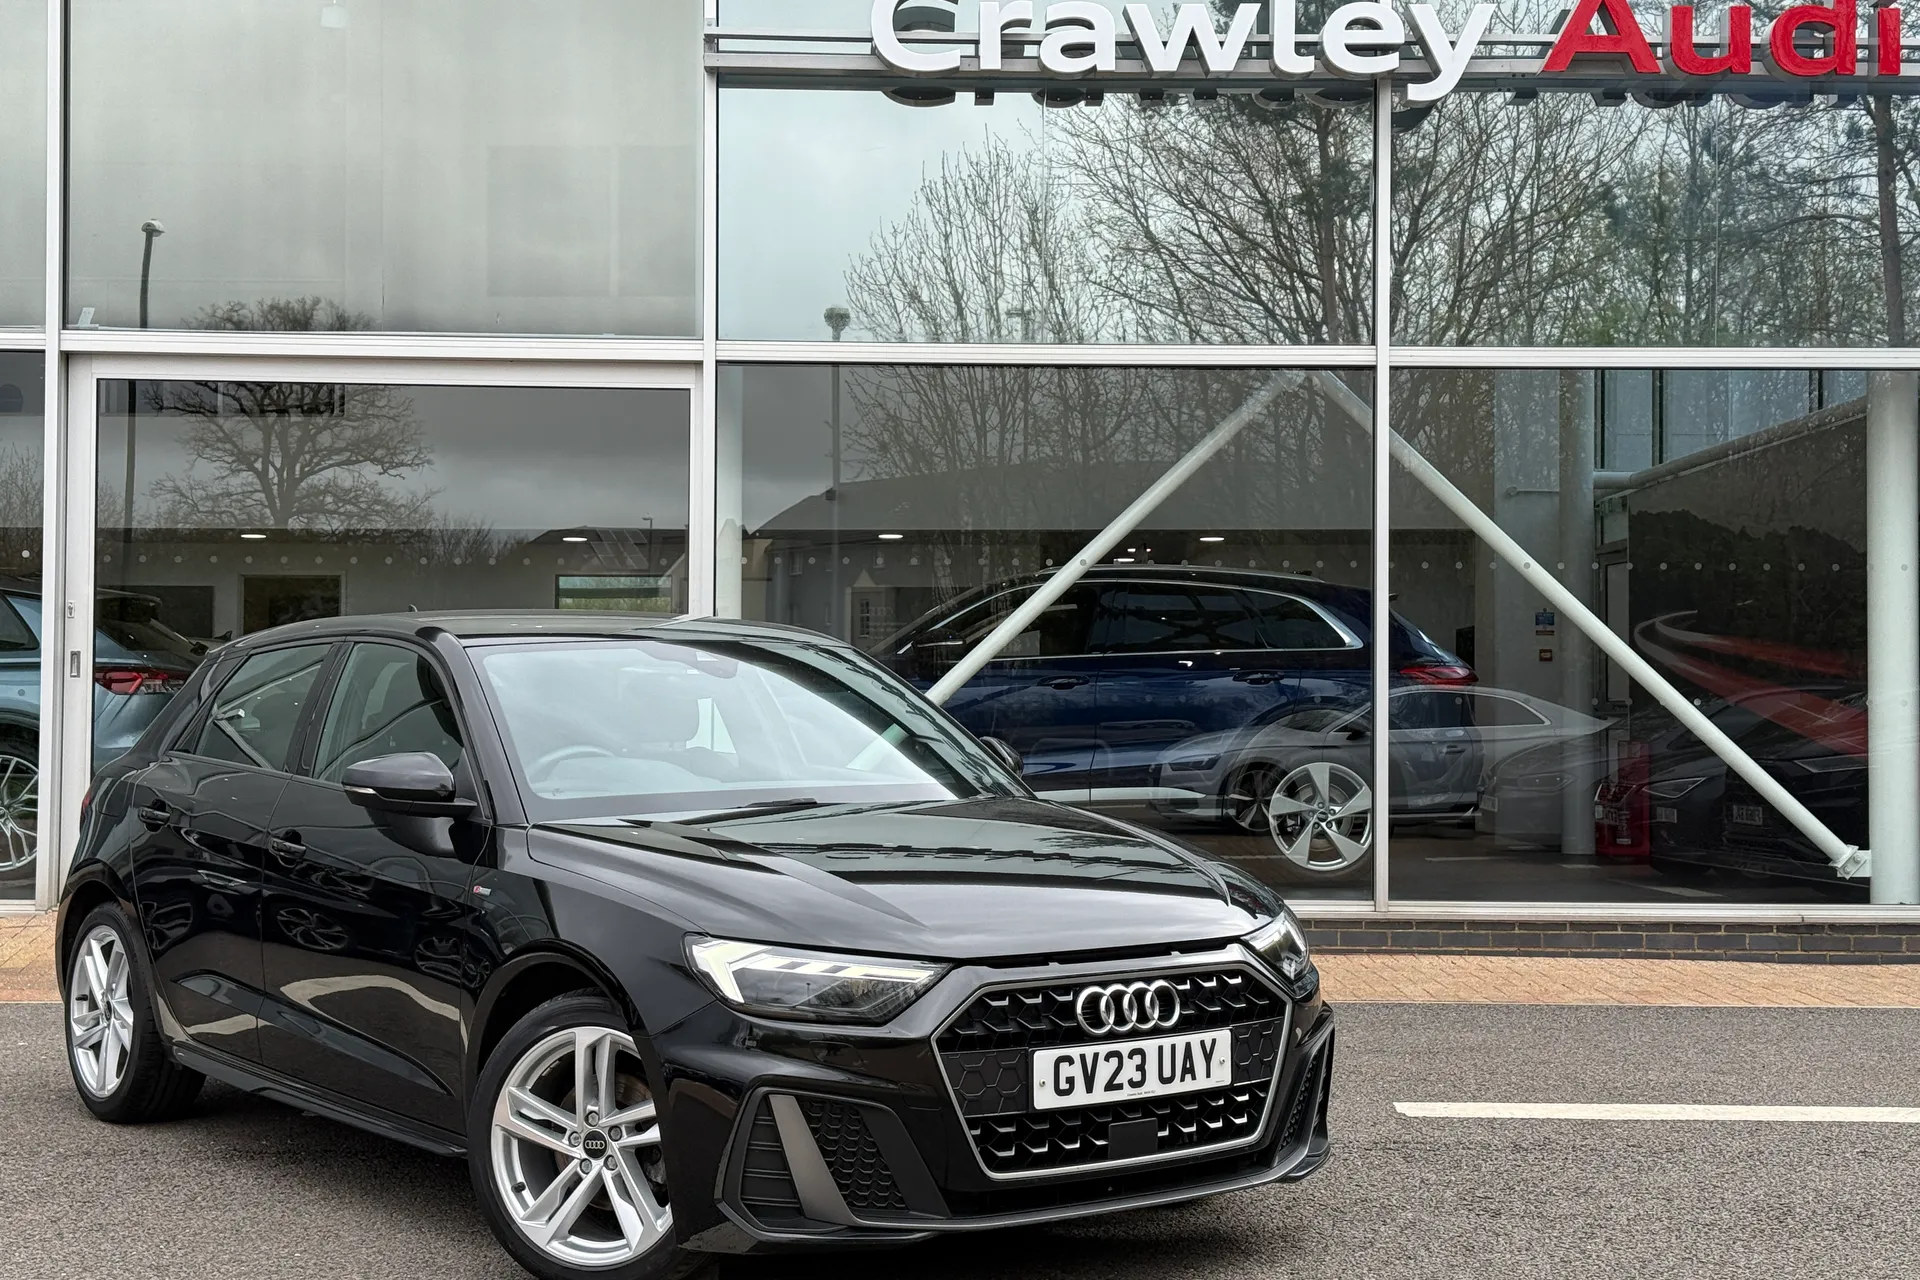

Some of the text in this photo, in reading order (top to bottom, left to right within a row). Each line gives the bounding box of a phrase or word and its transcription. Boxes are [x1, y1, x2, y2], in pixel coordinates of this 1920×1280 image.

[871, 0, 1900, 101] Crawley Audi
[1053, 1037, 1217, 1097] GV23 UAY
